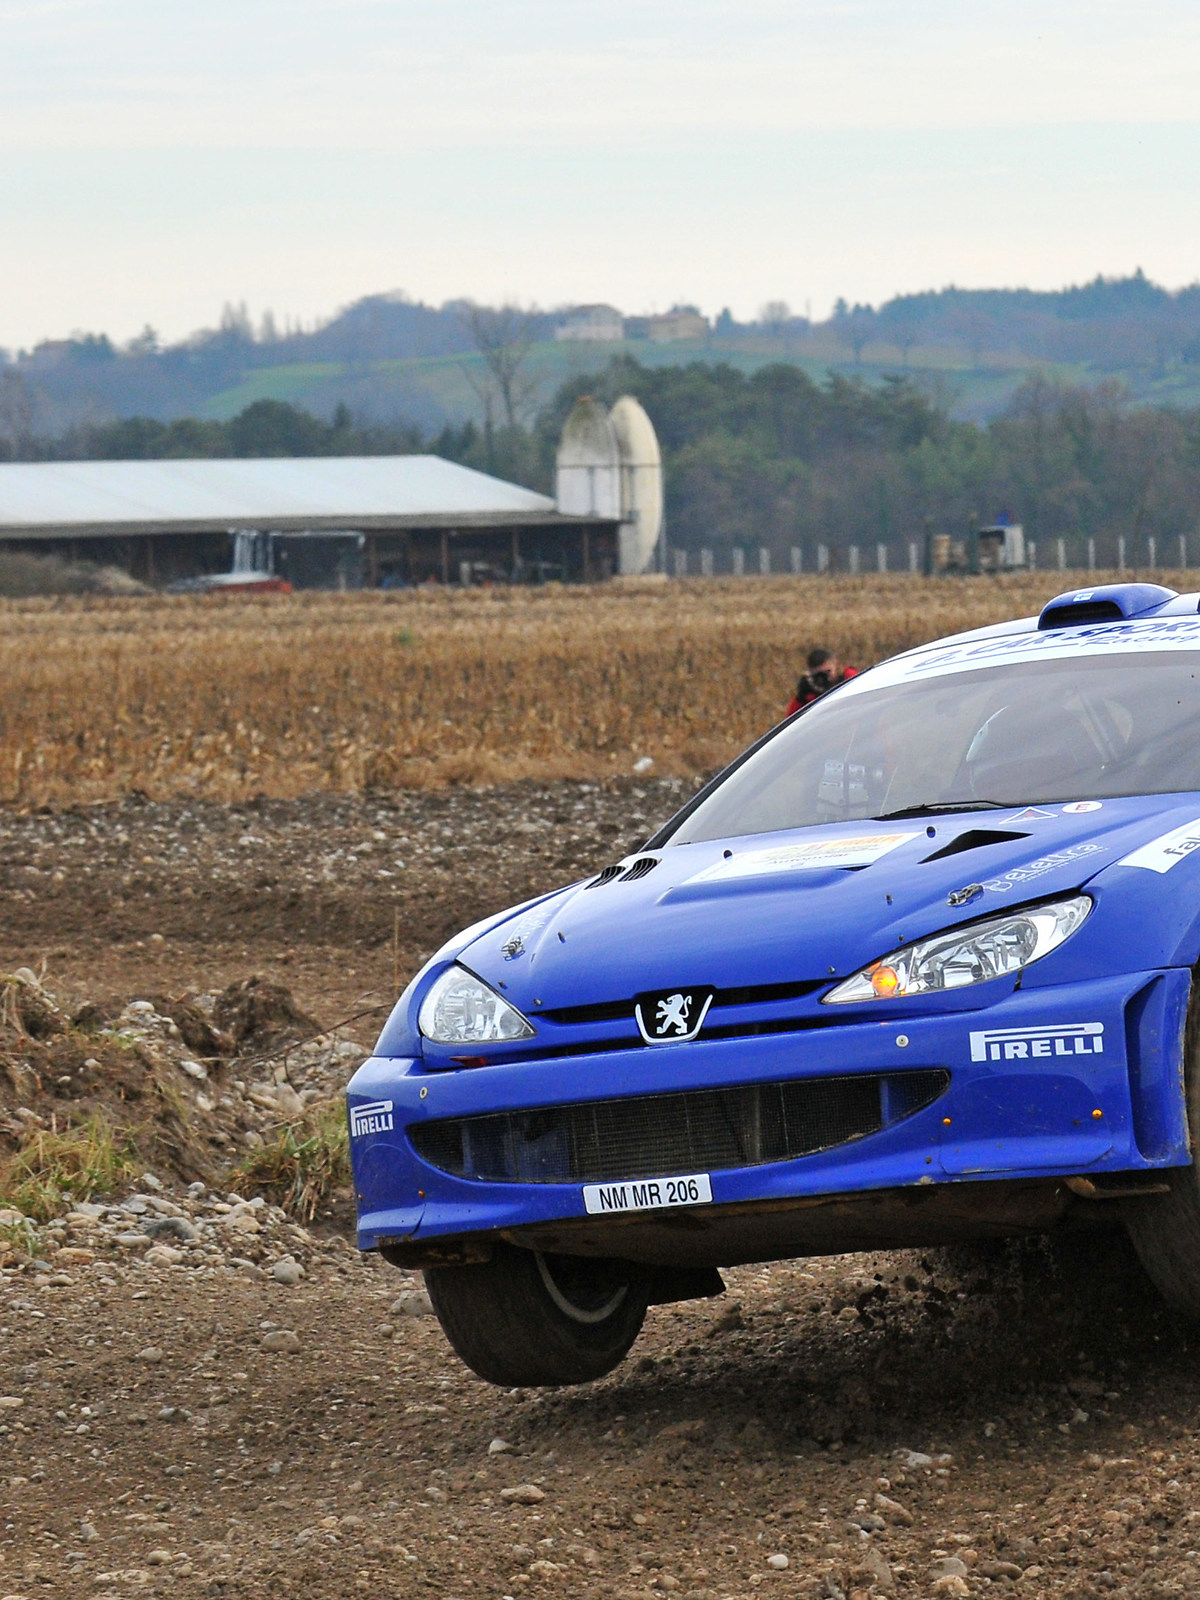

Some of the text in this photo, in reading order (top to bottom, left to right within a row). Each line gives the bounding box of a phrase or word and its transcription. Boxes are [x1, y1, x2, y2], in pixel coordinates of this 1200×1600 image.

[1081, 633, 1200, 648] Racing
[969, 1022, 1105, 1062] PIRELLI
[350, 1100, 394, 1137] PIRELLI
[599, 1179, 699, 1210] NM MR 206
